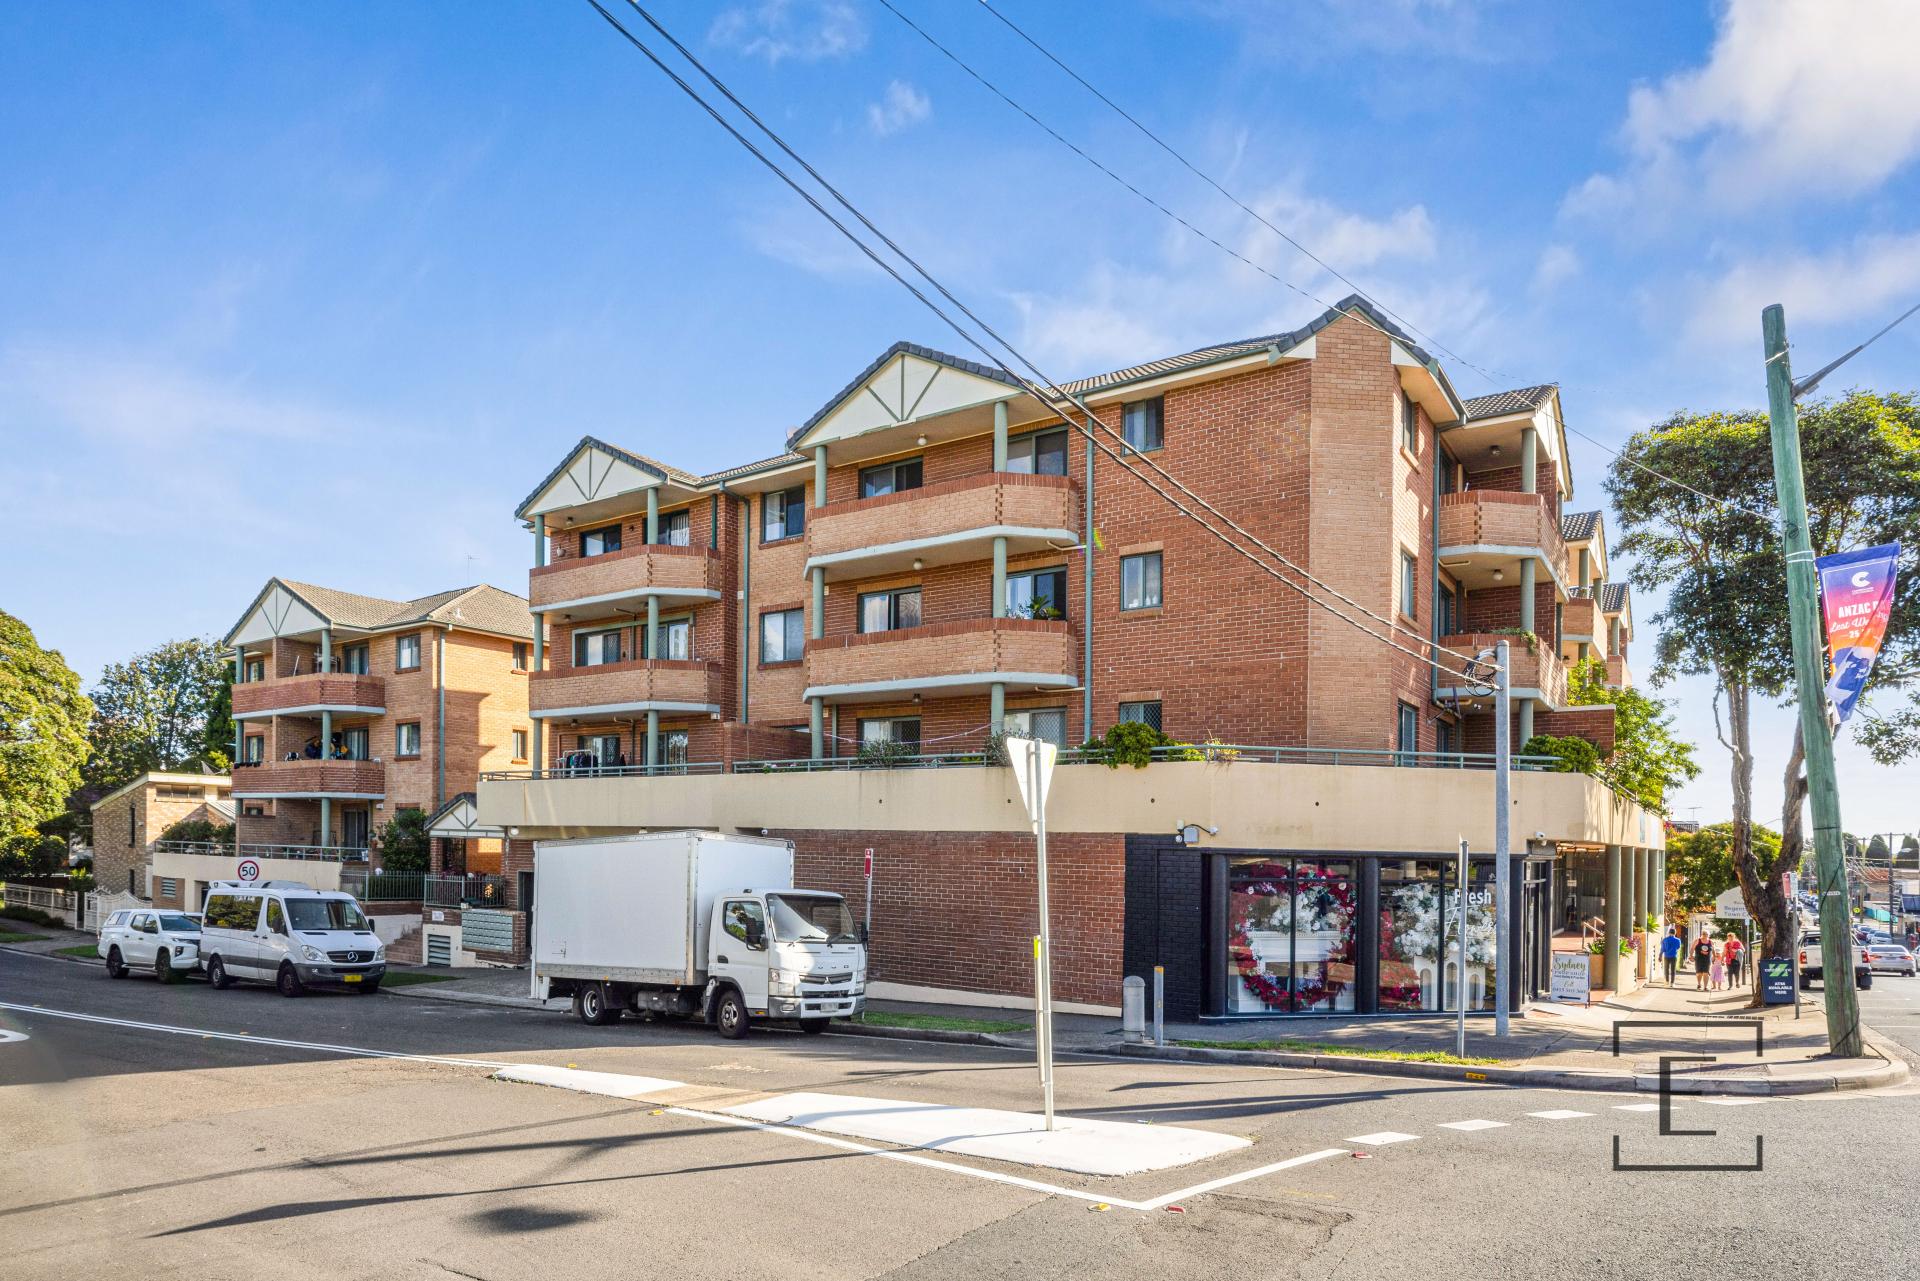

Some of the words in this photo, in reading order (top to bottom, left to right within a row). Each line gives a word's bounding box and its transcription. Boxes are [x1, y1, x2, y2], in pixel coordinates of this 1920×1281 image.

[1838, 602, 1871, 618] ANZAC
[241, 866, 256, 877] 50
[1454, 888, 1492, 905] Fesh
[1553, 957, 1586, 972] Sydney
